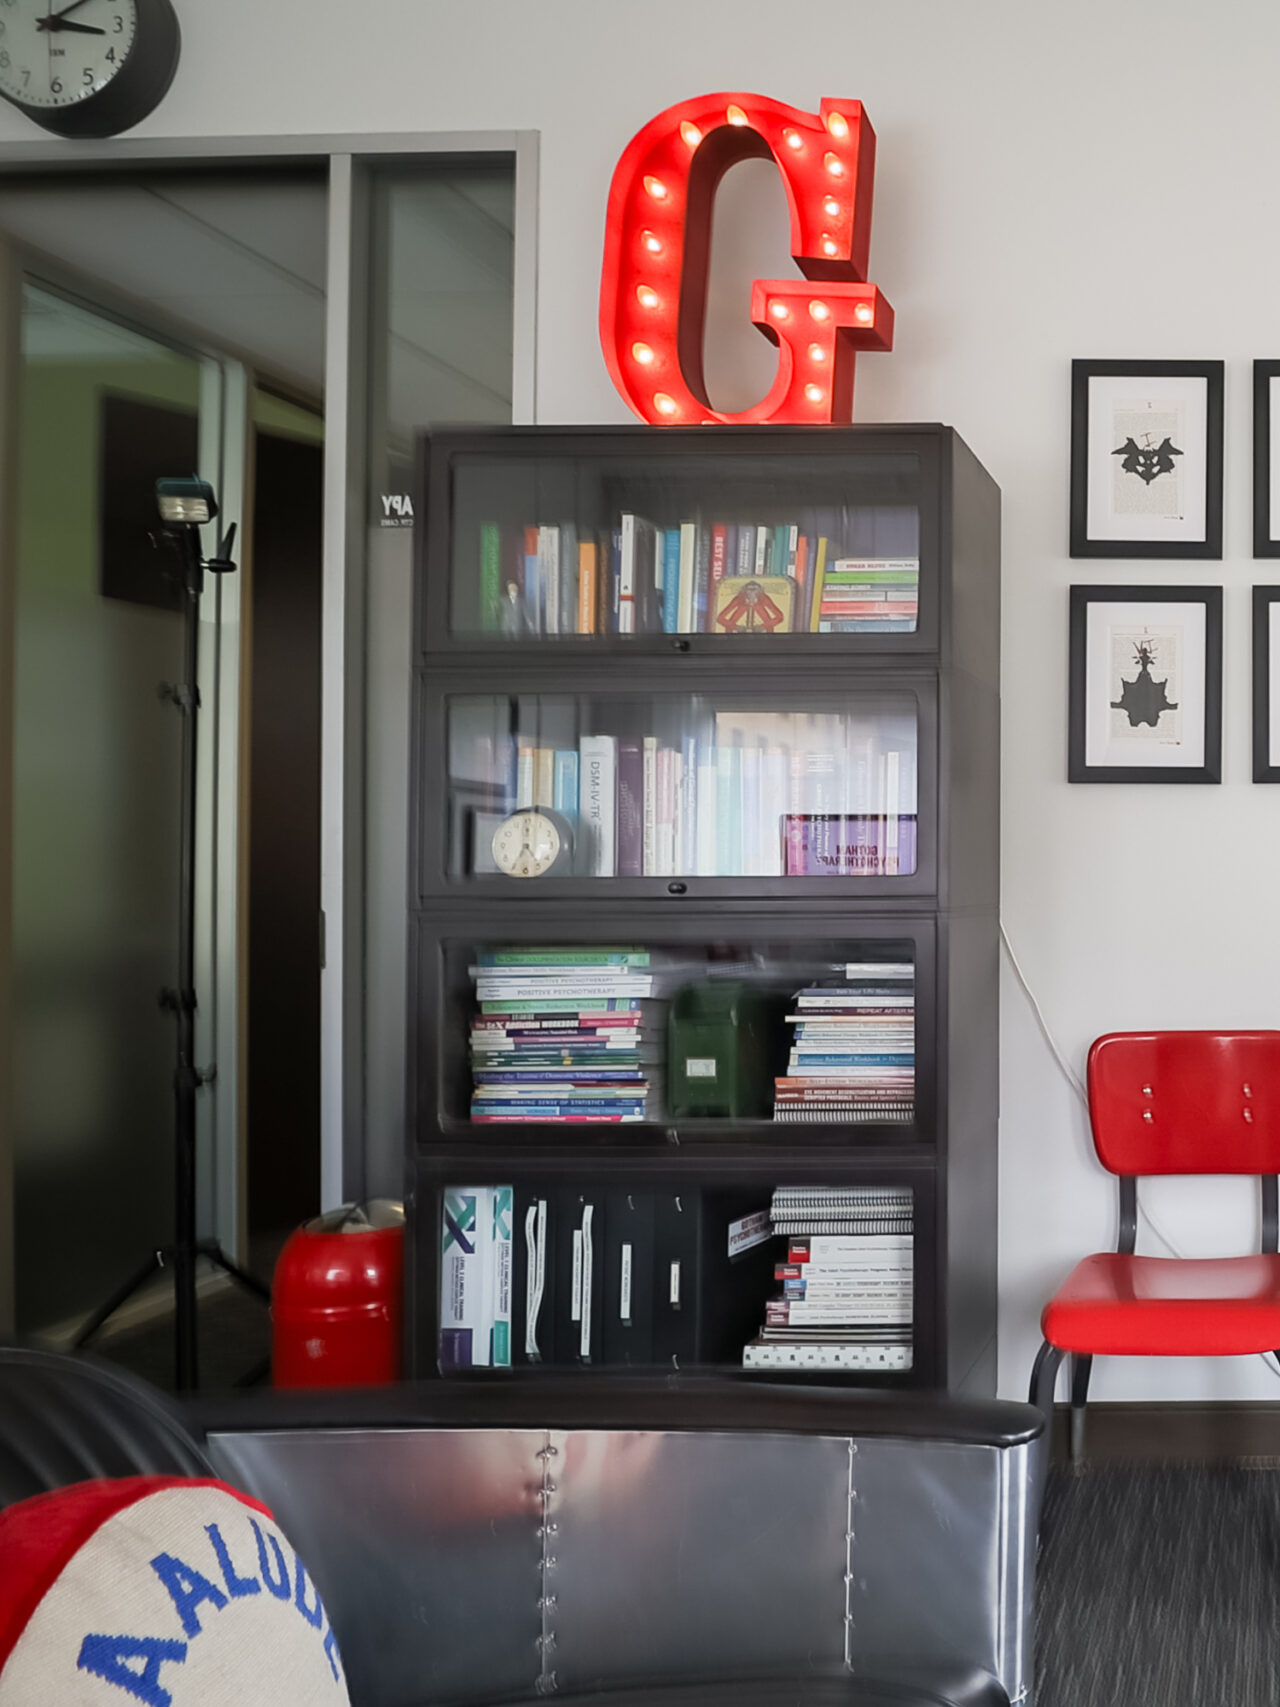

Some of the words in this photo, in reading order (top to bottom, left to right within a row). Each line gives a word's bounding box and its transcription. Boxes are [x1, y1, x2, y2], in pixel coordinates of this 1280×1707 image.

[113, 16, 123, 33] 3
[105, 47, 116, 63] 4
[21, 70, 31, 87] 7
[51, 77, 63, 93] 6
[82, 68, 94, 86] 5
[599, 91, 894, 427] G
[714, 536, 724, 558] BEST
[517, 988, 551, 996] POSITIVE
[553, 987, 616, 995] PSYCHOTHERAPY
